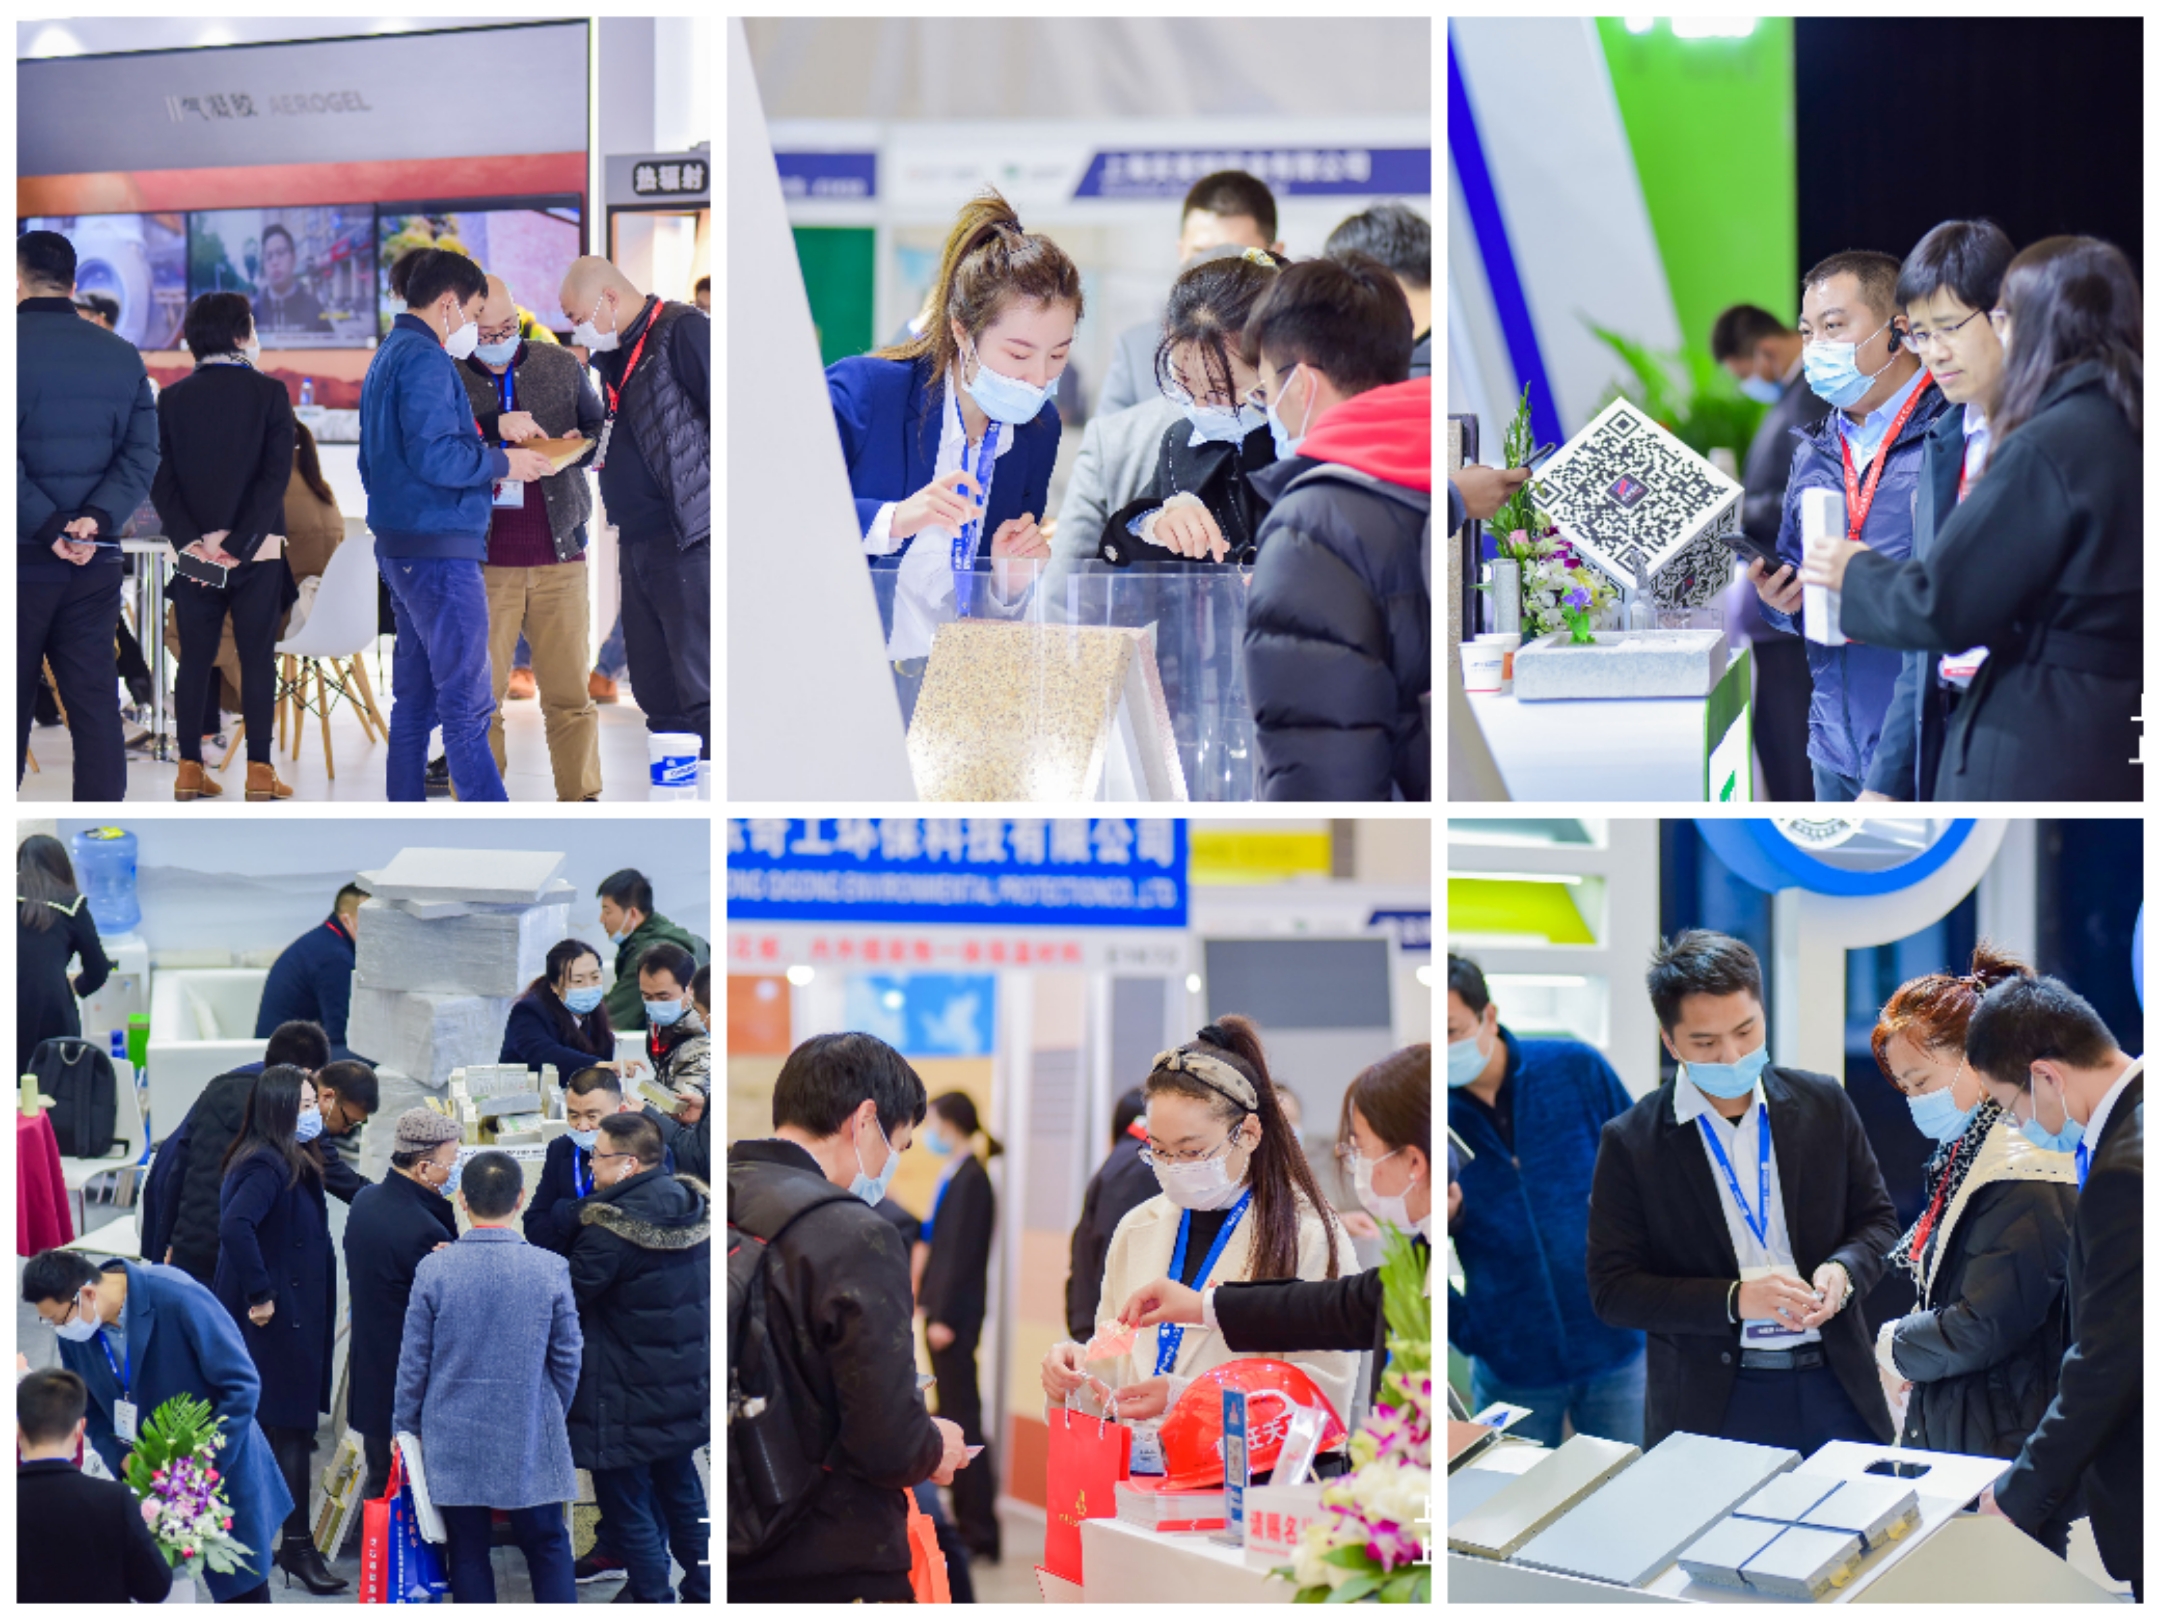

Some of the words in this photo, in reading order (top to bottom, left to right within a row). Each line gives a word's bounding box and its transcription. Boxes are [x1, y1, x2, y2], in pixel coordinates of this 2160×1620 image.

[269, 91, 373, 117] AEROGEL
[635, 162, 705, 193] 热辐射
